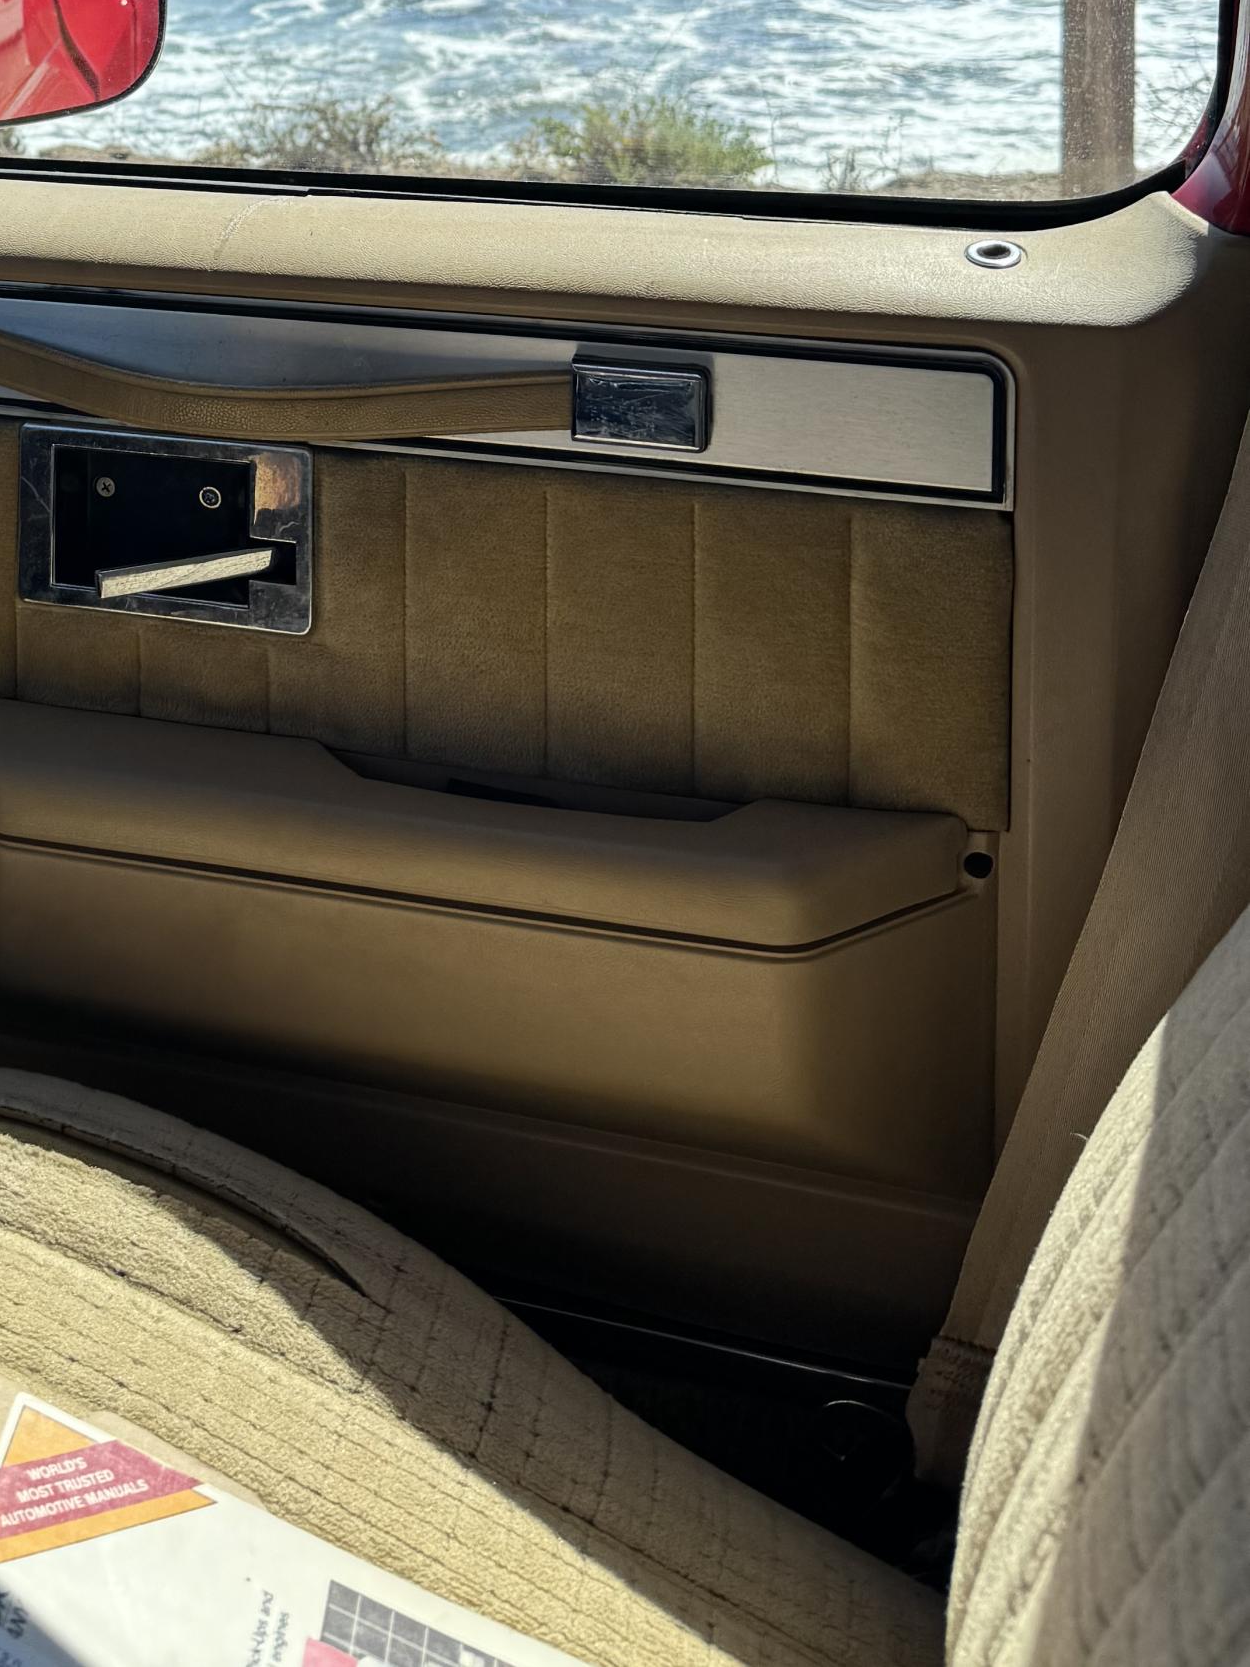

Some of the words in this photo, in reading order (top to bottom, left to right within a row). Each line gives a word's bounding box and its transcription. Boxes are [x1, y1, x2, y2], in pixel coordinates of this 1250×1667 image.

[26, 1456, 88, 1481] WORLD'S
[0, 1494, 87, 1527] AUTOMOTIVE
[85, 1479, 149, 1505] MANUALS
[15, 1485, 55, 1503] MOST
[52, 1469, 115, 1494] TRUSTED
